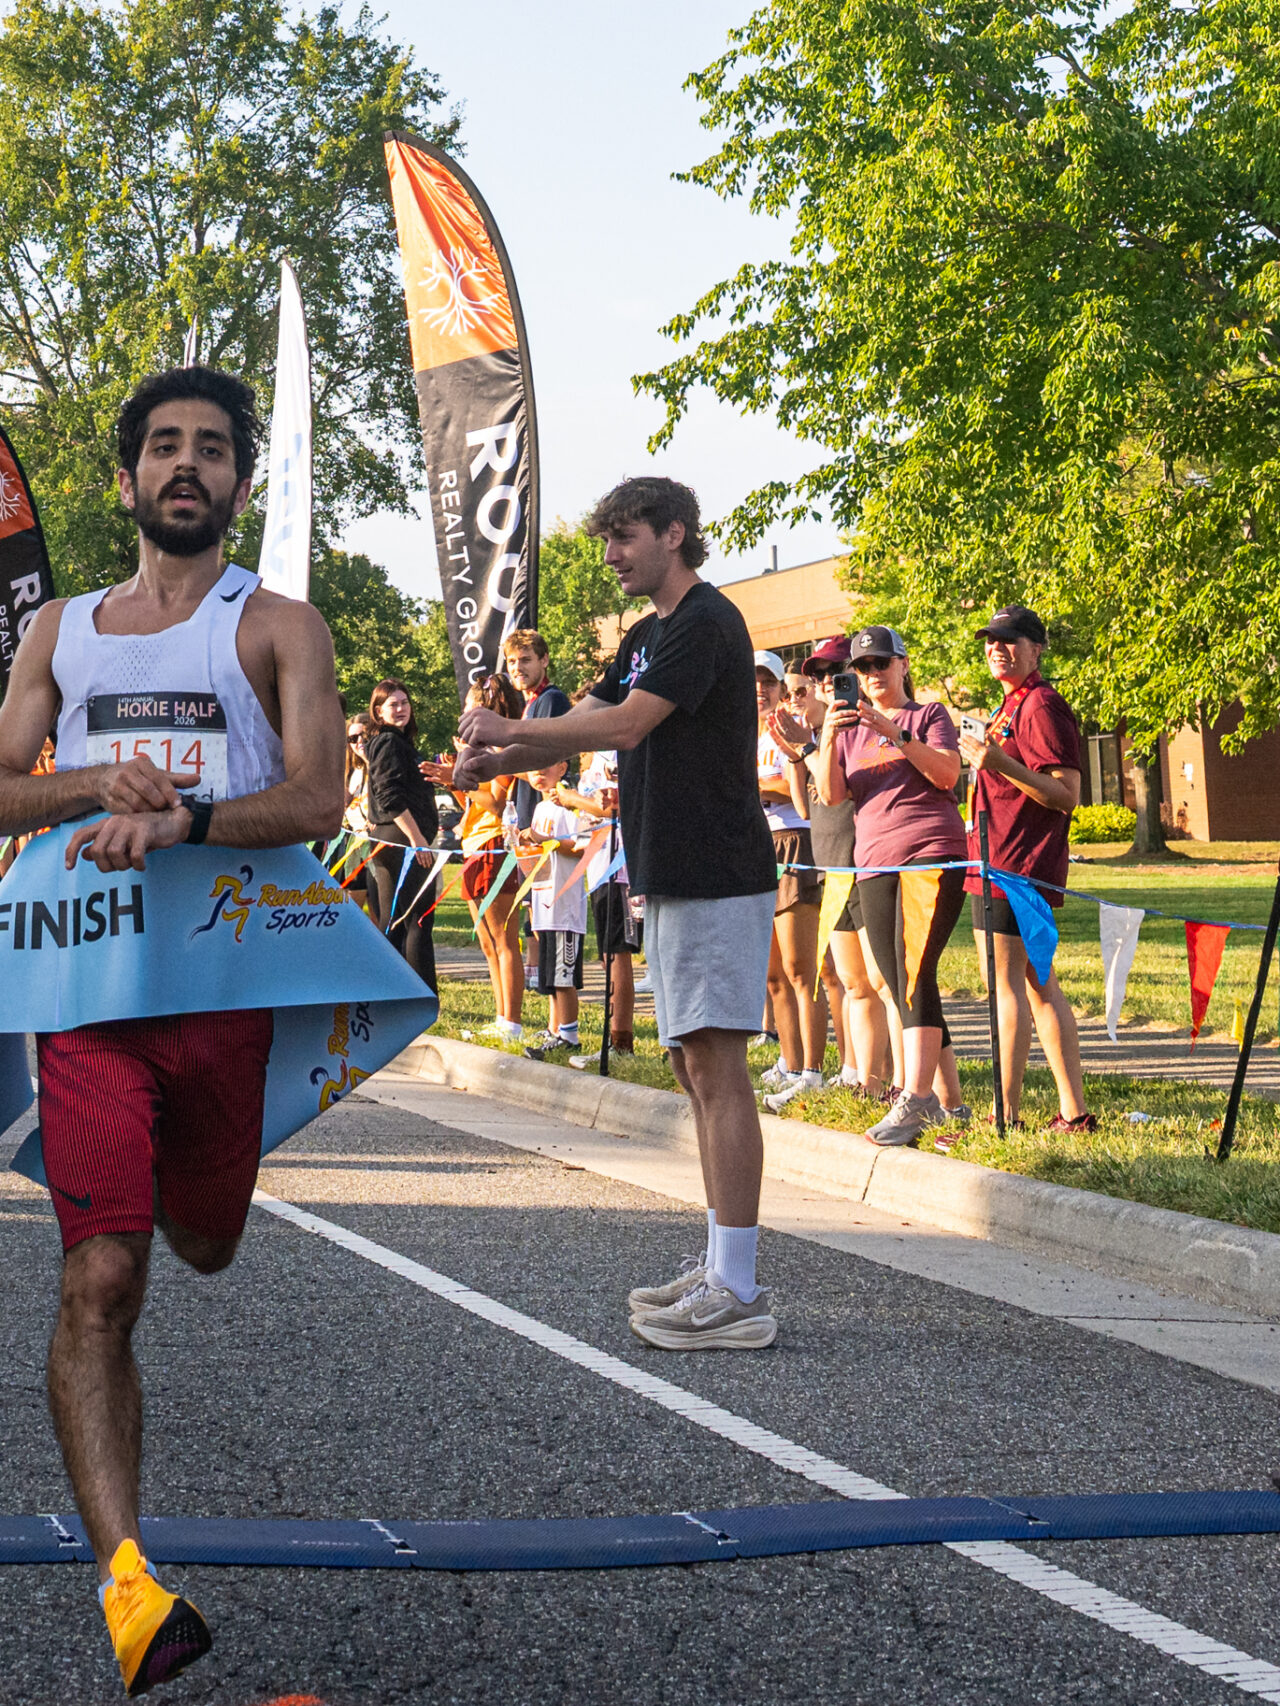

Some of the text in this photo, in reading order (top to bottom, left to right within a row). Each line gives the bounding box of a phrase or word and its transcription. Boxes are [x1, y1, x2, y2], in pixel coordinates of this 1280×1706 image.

[438, 470, 488, 686] REALTY GROU
[117, 701, 217, 718] HOKIE HALF
[174, 716, 196, 726] 2026
[110, 739, 206, 775] 1514
[266, 906, 340, 934] Sports
